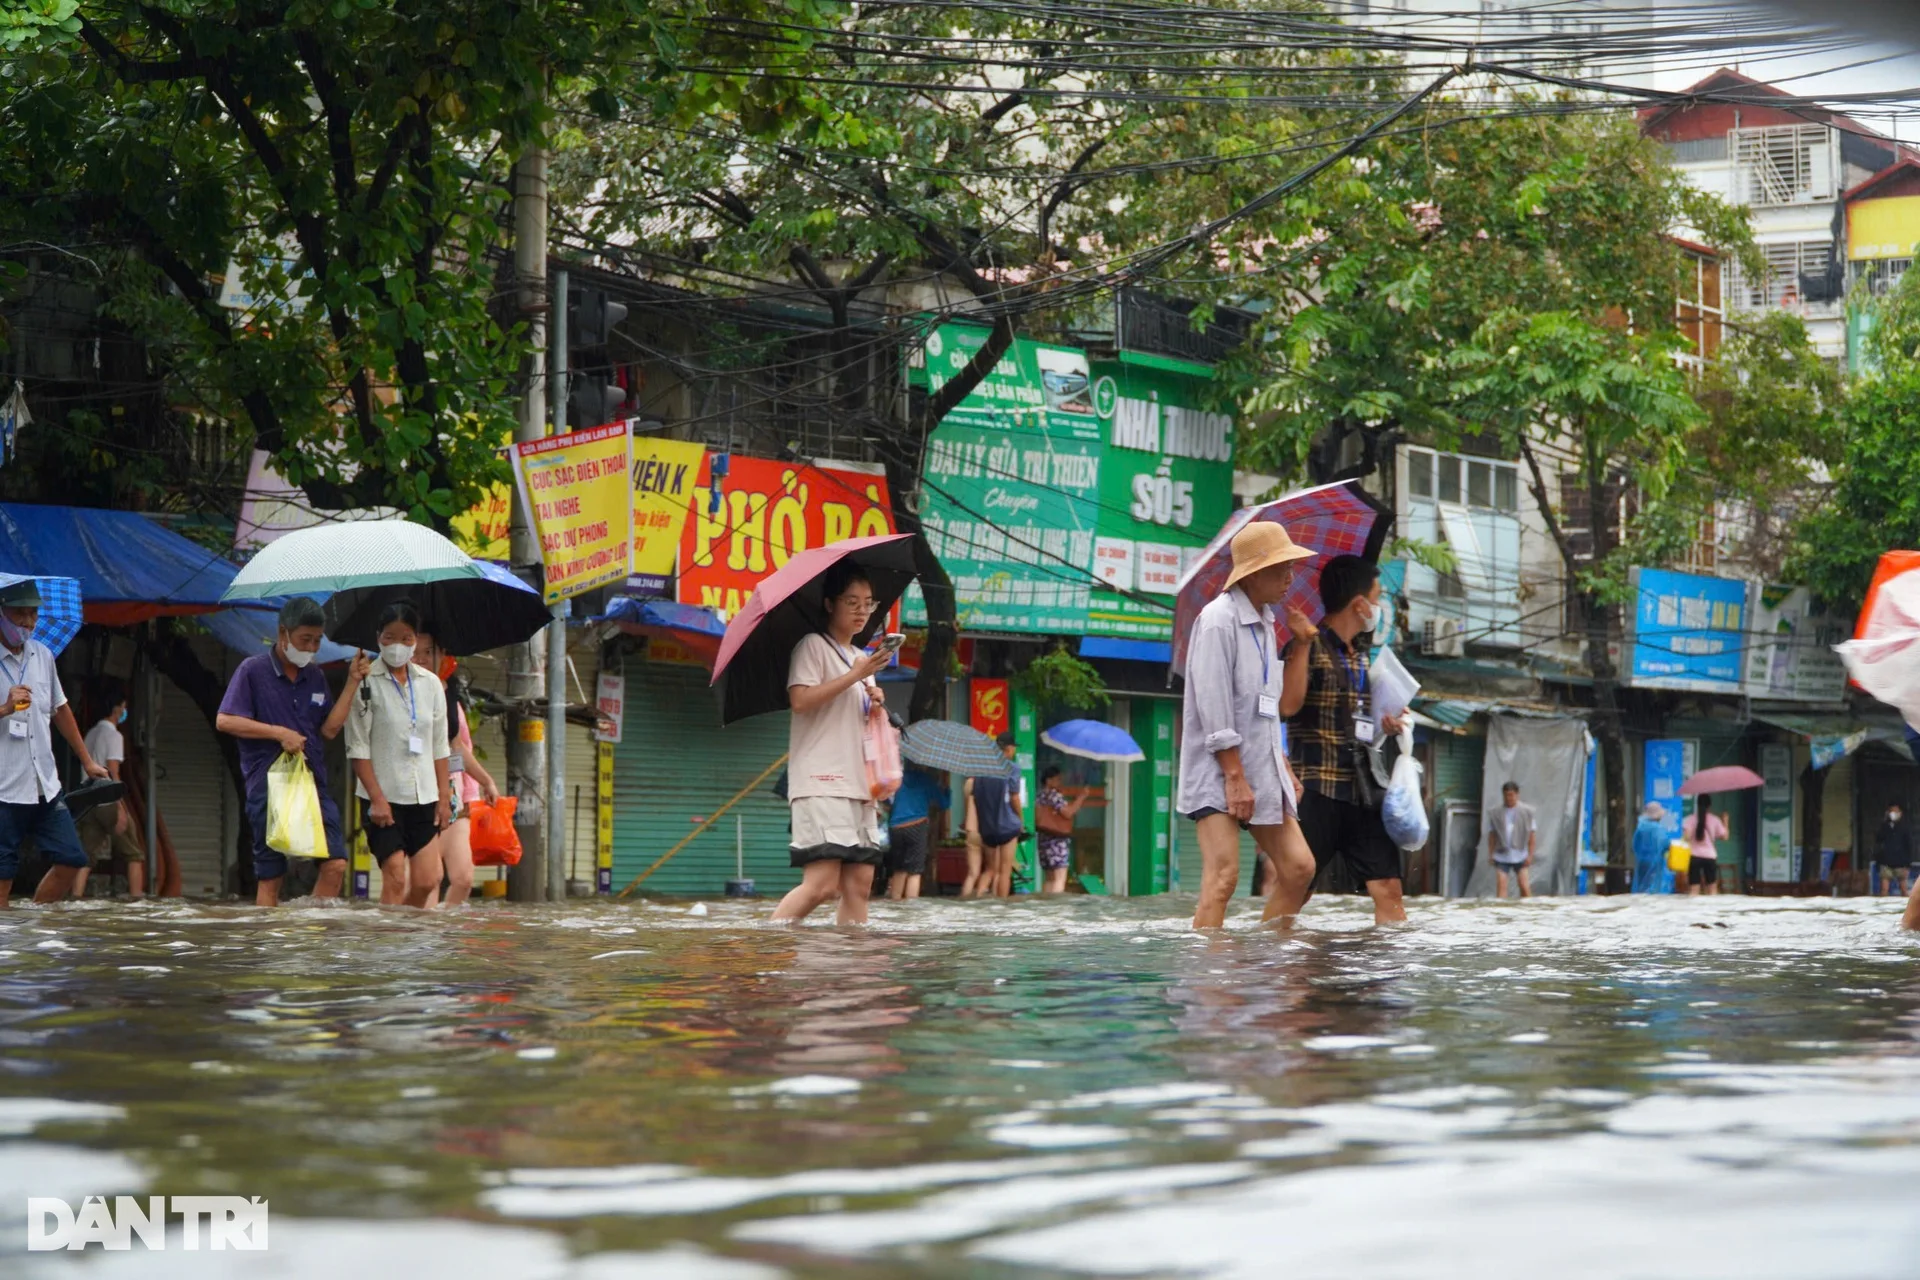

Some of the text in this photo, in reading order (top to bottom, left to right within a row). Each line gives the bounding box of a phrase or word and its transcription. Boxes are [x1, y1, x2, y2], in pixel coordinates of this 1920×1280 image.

[1110, 390, 1160, 453] NHÀ
[532, 470, 553, 492] CỤC
[555, 466, 575, 489] SẠC
[576, 458, 600, 483] ĐIỆN
[601, 453, 626, 475] THOẠI
[671, 463, 688, 495] K
[930, 439, 960, 484] ĐẠI
[963, 436, 986, 478] LÝ
[1052, 446, 1099, 497] THIỆN
[535, 496, 581, 522] TAI NGHE
[692, 469, 808, 573] PHỞ
[541, 532, 561, 555] SẠC
[563, 527, 577, 551] DỰ
[701, 585, 754, 623] NA
